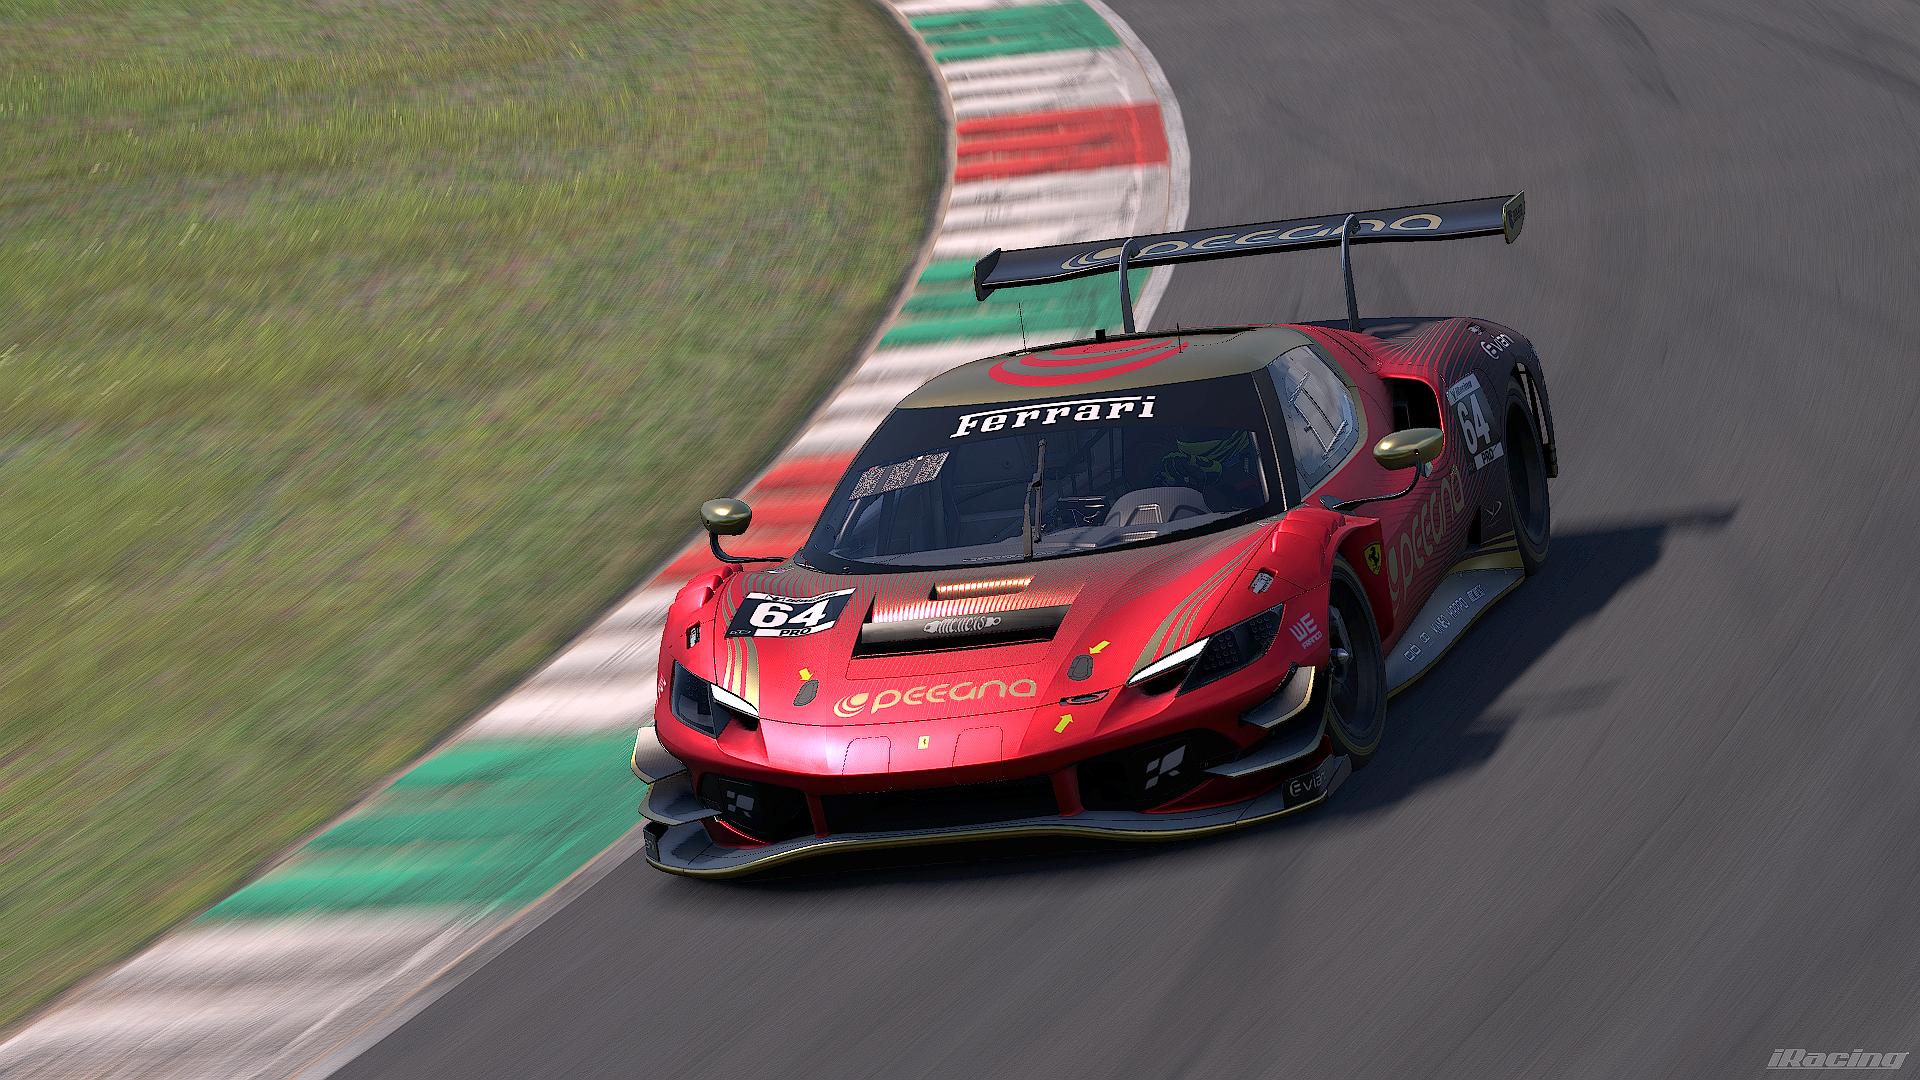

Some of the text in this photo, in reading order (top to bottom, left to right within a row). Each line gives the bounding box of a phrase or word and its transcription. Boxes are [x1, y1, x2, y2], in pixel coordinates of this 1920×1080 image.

[950, 396, 1156, 439] Ferrari
[1457, 393, 1491, 454] 64
[1481, 447, 1495, 465] PRO
[749, 599, 829, 628] 64
[1289, 612, 1318, 642] WE
[780, 627, 812, 637] PRO
[871, 678, 1037, 715] peeana
